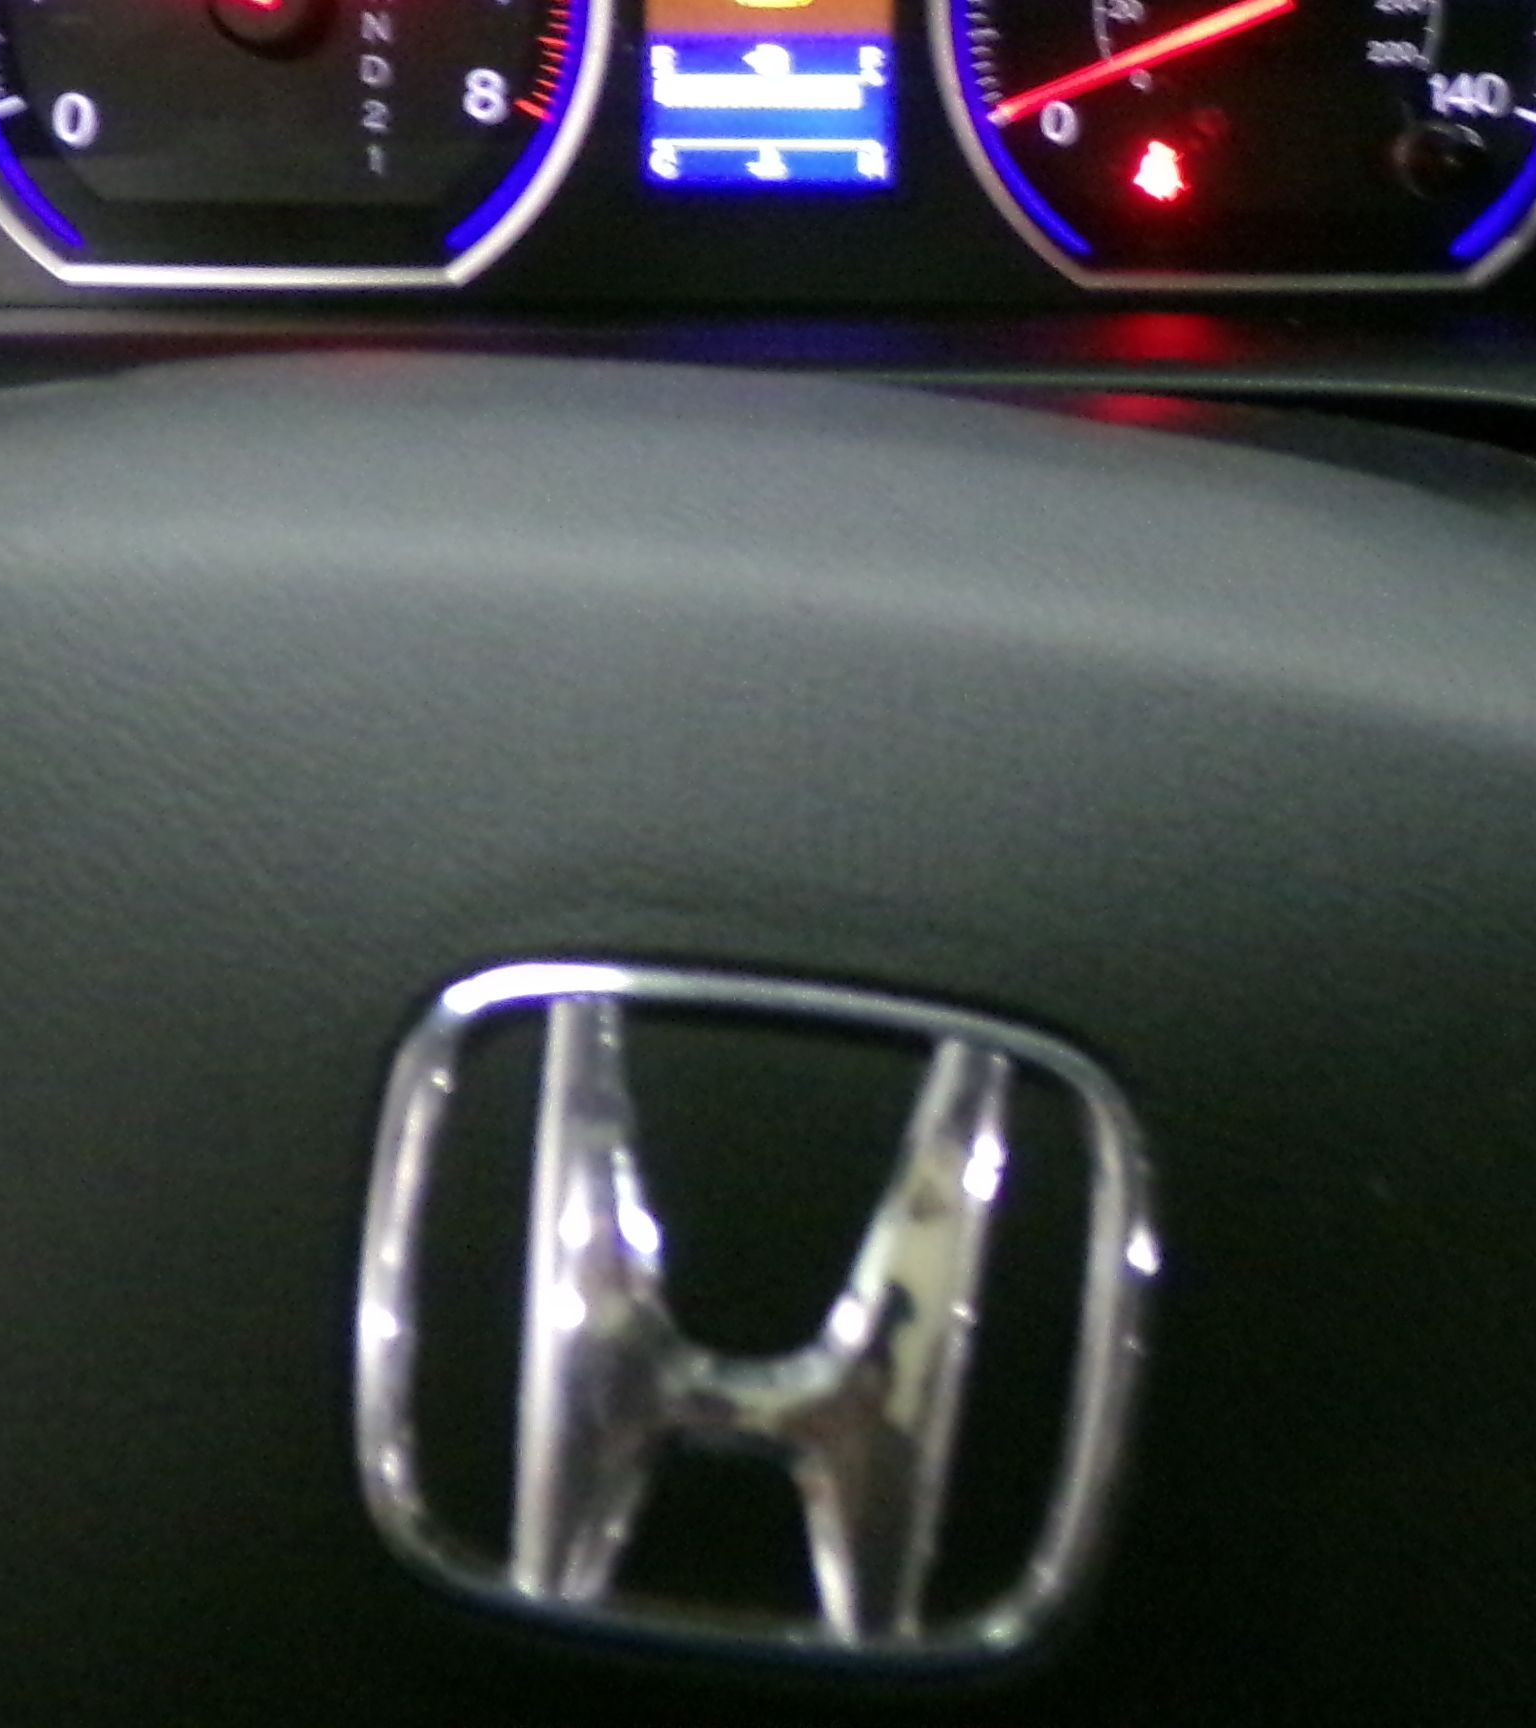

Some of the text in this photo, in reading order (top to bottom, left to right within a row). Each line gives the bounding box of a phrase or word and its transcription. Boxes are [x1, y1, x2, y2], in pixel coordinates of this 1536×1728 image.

[360, 53, 392, 88] D
[463, 68, 508, 125] 8
[1427, 73, 1511, 119] 140
[51, 92, 98, 148] 0
[1039, 100, 1079, 147] 0
